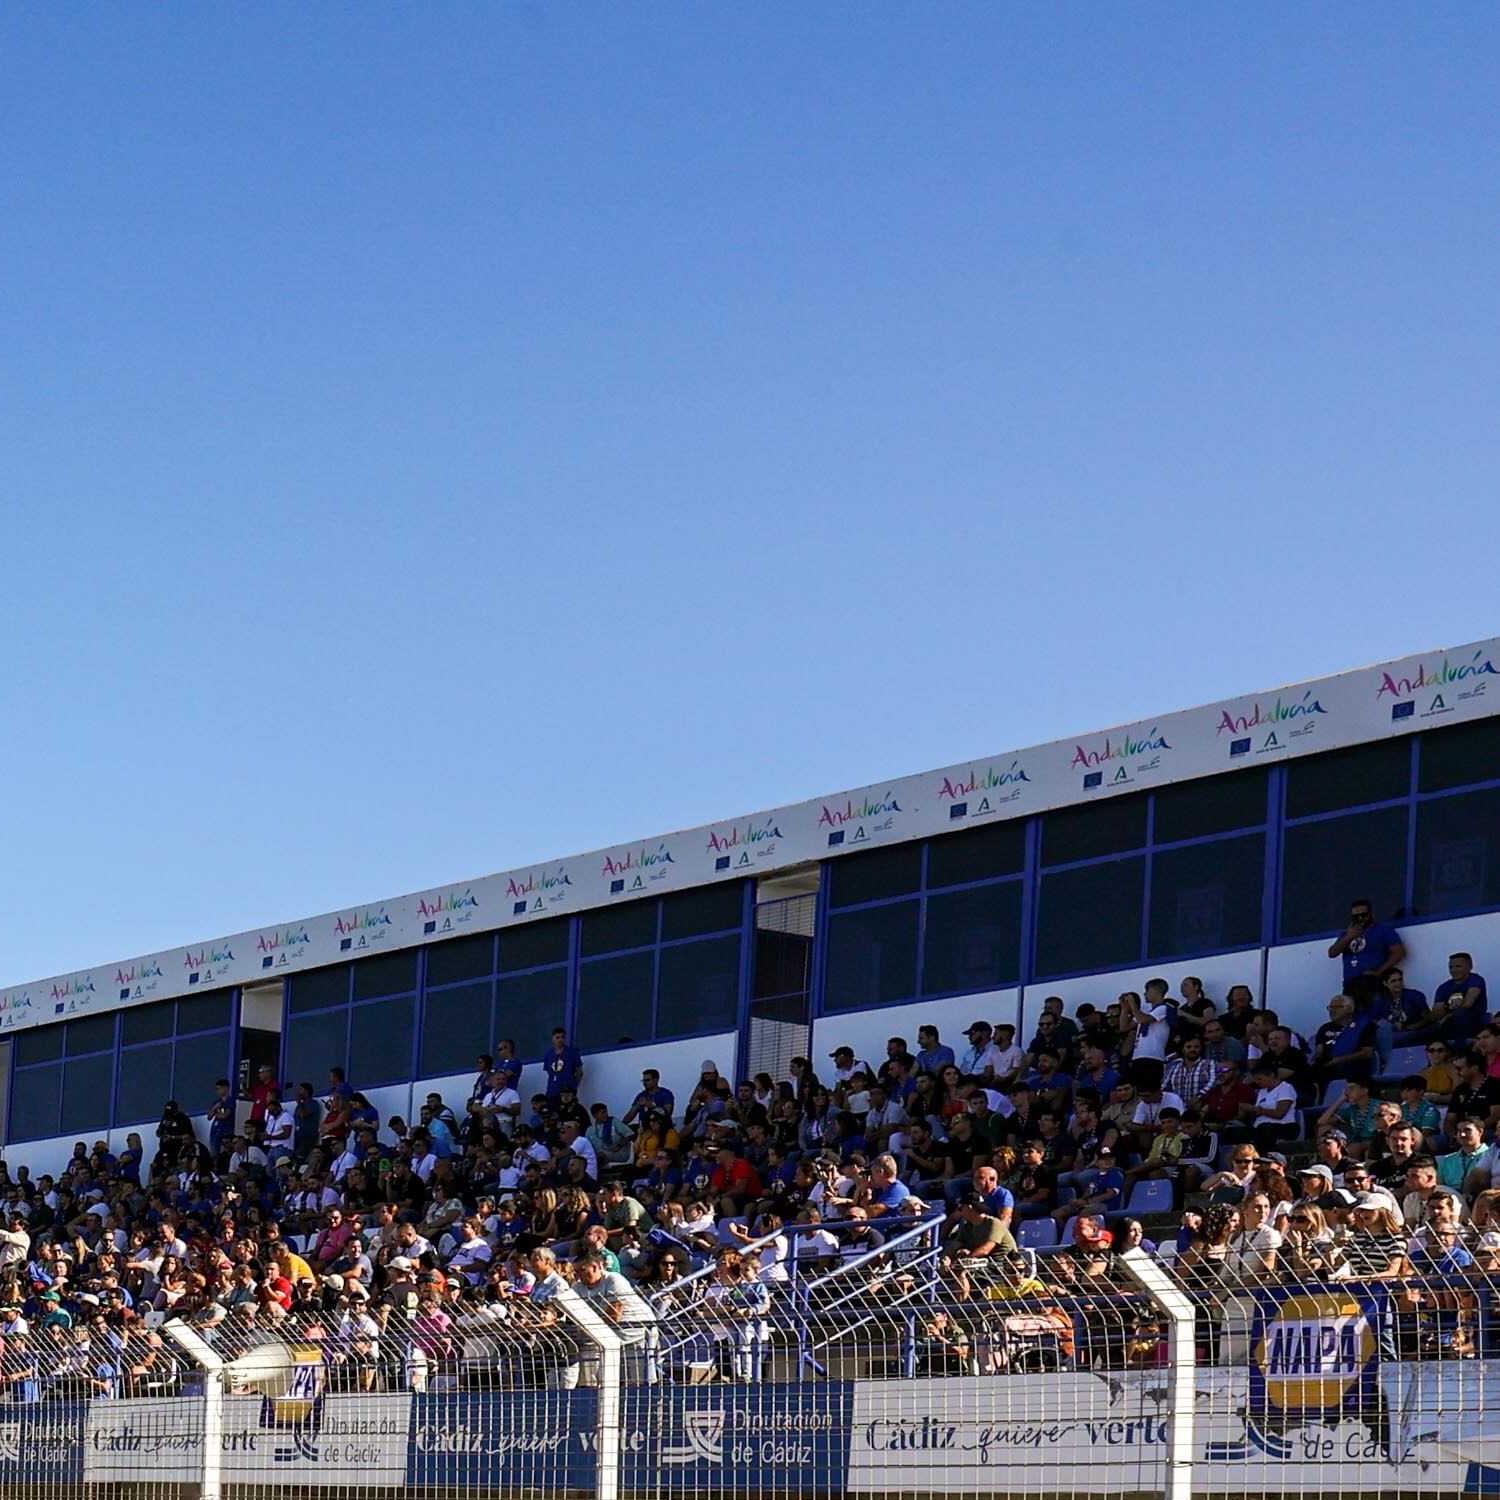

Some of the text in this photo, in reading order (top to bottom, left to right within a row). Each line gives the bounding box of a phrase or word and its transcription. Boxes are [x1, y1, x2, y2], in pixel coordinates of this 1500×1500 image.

[1270, 1324, 1357, 1375] NAPA
[733, 1408, 832, 1432] Diputación
[93, 1427, 142, 1451] Cádiz
[220, 1429, 258, 1451] erte
[416, 1425, 484, 1454] Cádiz
[866, 1415, 957, 1451] Cádiz
[323, 1444, 340, 1463] de
[731, 1438, 812, 1464] de Cádiz
[1304, 1435, 1333, 1460] de
